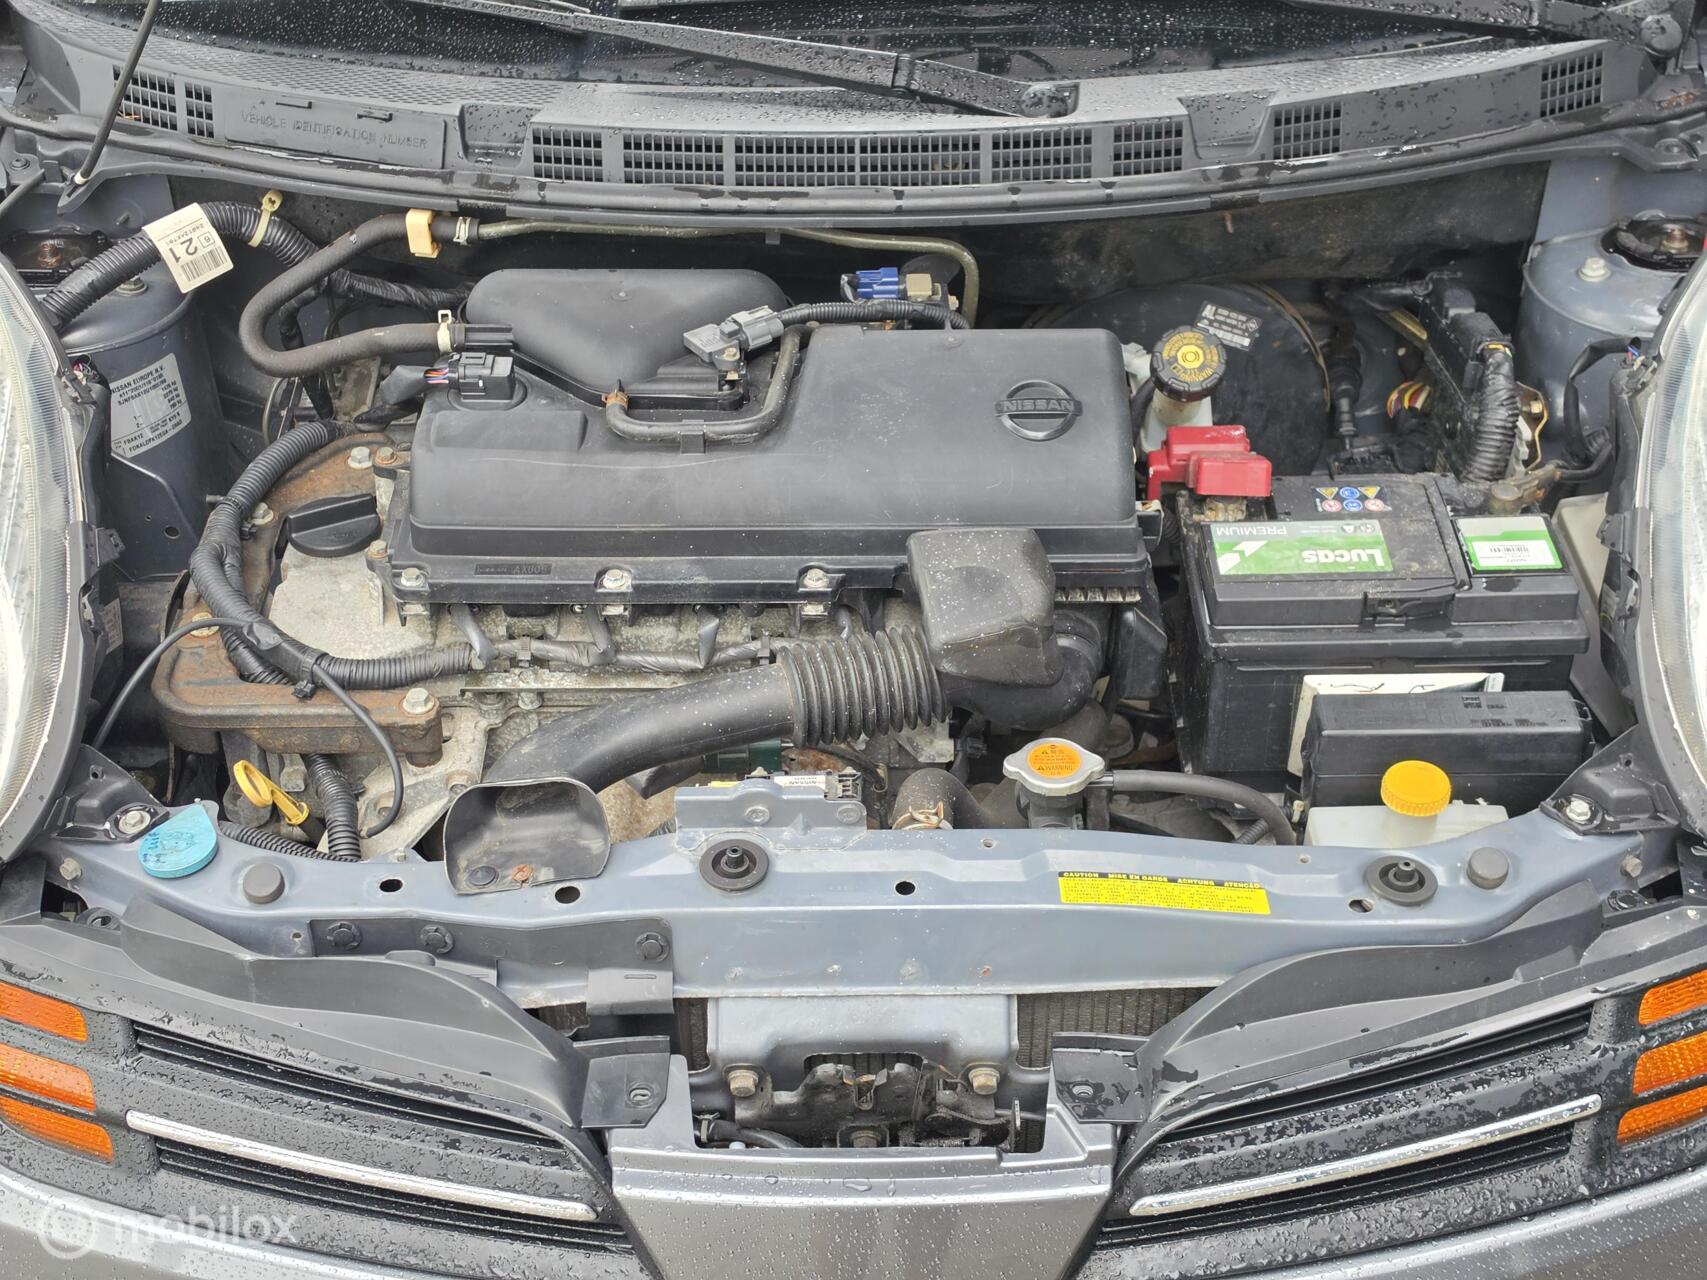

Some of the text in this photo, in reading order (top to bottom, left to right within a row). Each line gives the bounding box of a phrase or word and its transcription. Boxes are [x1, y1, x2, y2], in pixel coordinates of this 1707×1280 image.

[241, 111, 429, 149] VEHICLE IDENTIFICATION NUMBER
[133, 371, 154, 385] EUROPE
[1003, 400, 1075, 411] NISSAN
[1216, 525, 1289, 536] PREMIUM
[1301, 548, 1385, 567] Lucas
